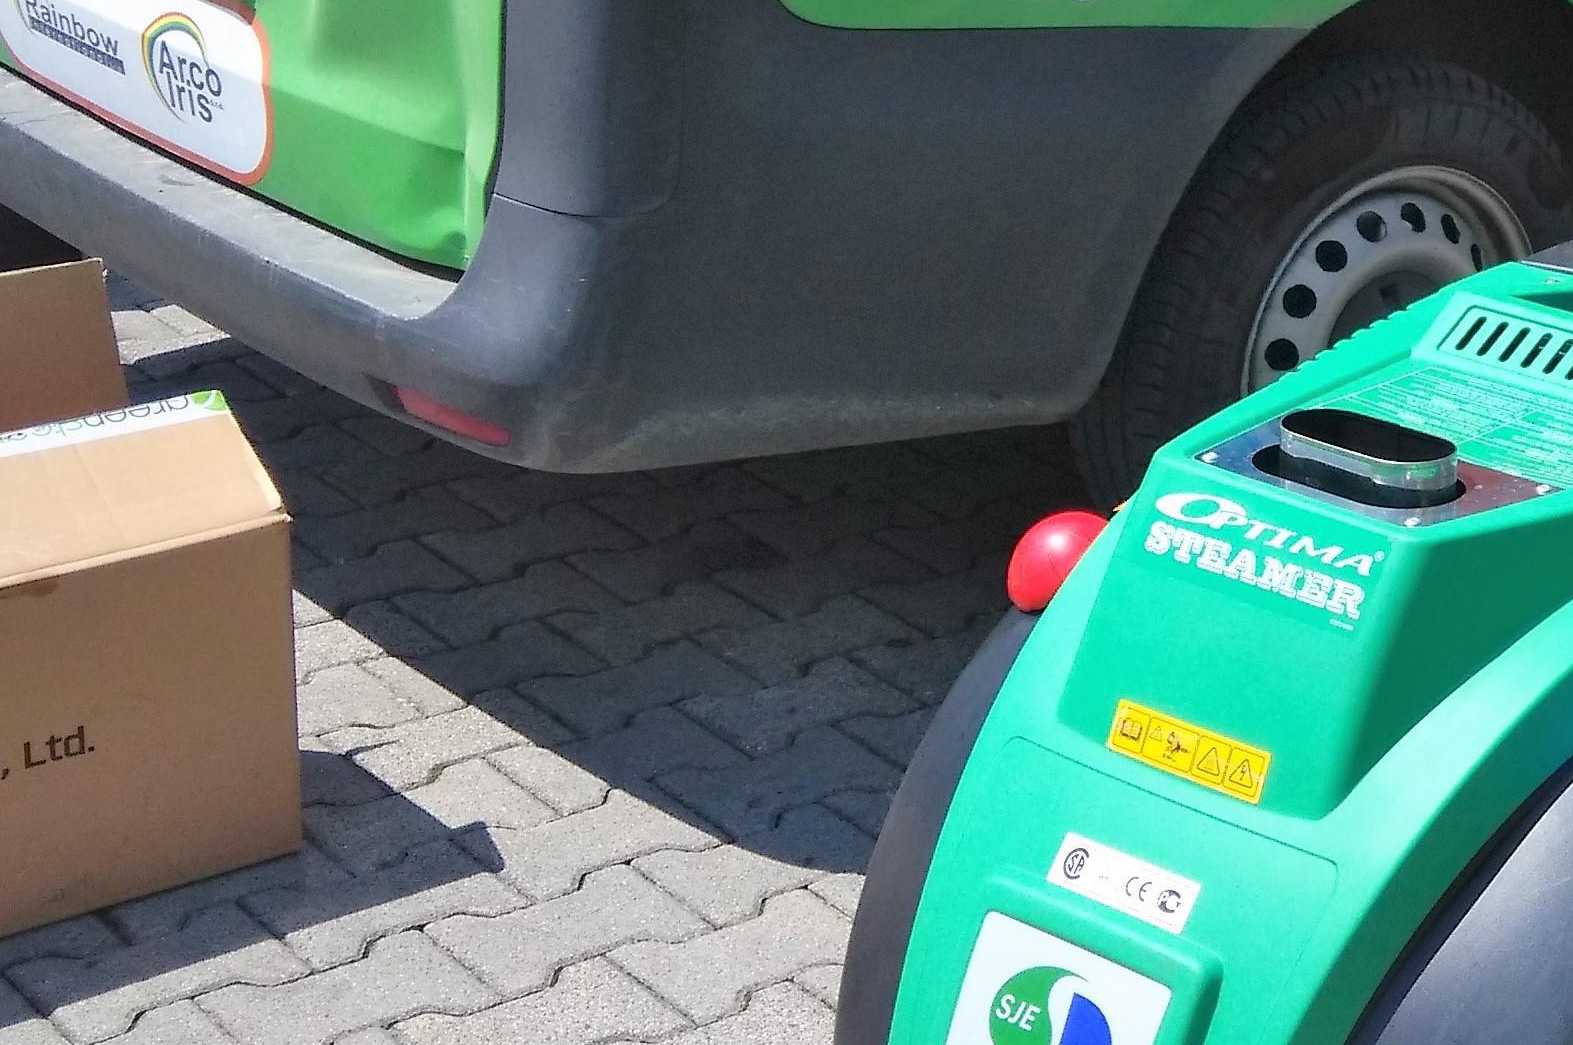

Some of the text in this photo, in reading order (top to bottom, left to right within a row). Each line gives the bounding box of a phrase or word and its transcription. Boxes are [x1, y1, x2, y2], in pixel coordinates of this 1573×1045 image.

[159, 40, 222, 97] Arco
[166, 69, 213, 123] Iris
[1144, 520, 1366, 620] STEAMER
[24, 725, 95, 769] Ltd.
[995, 994, 1041, 1032] SJE
